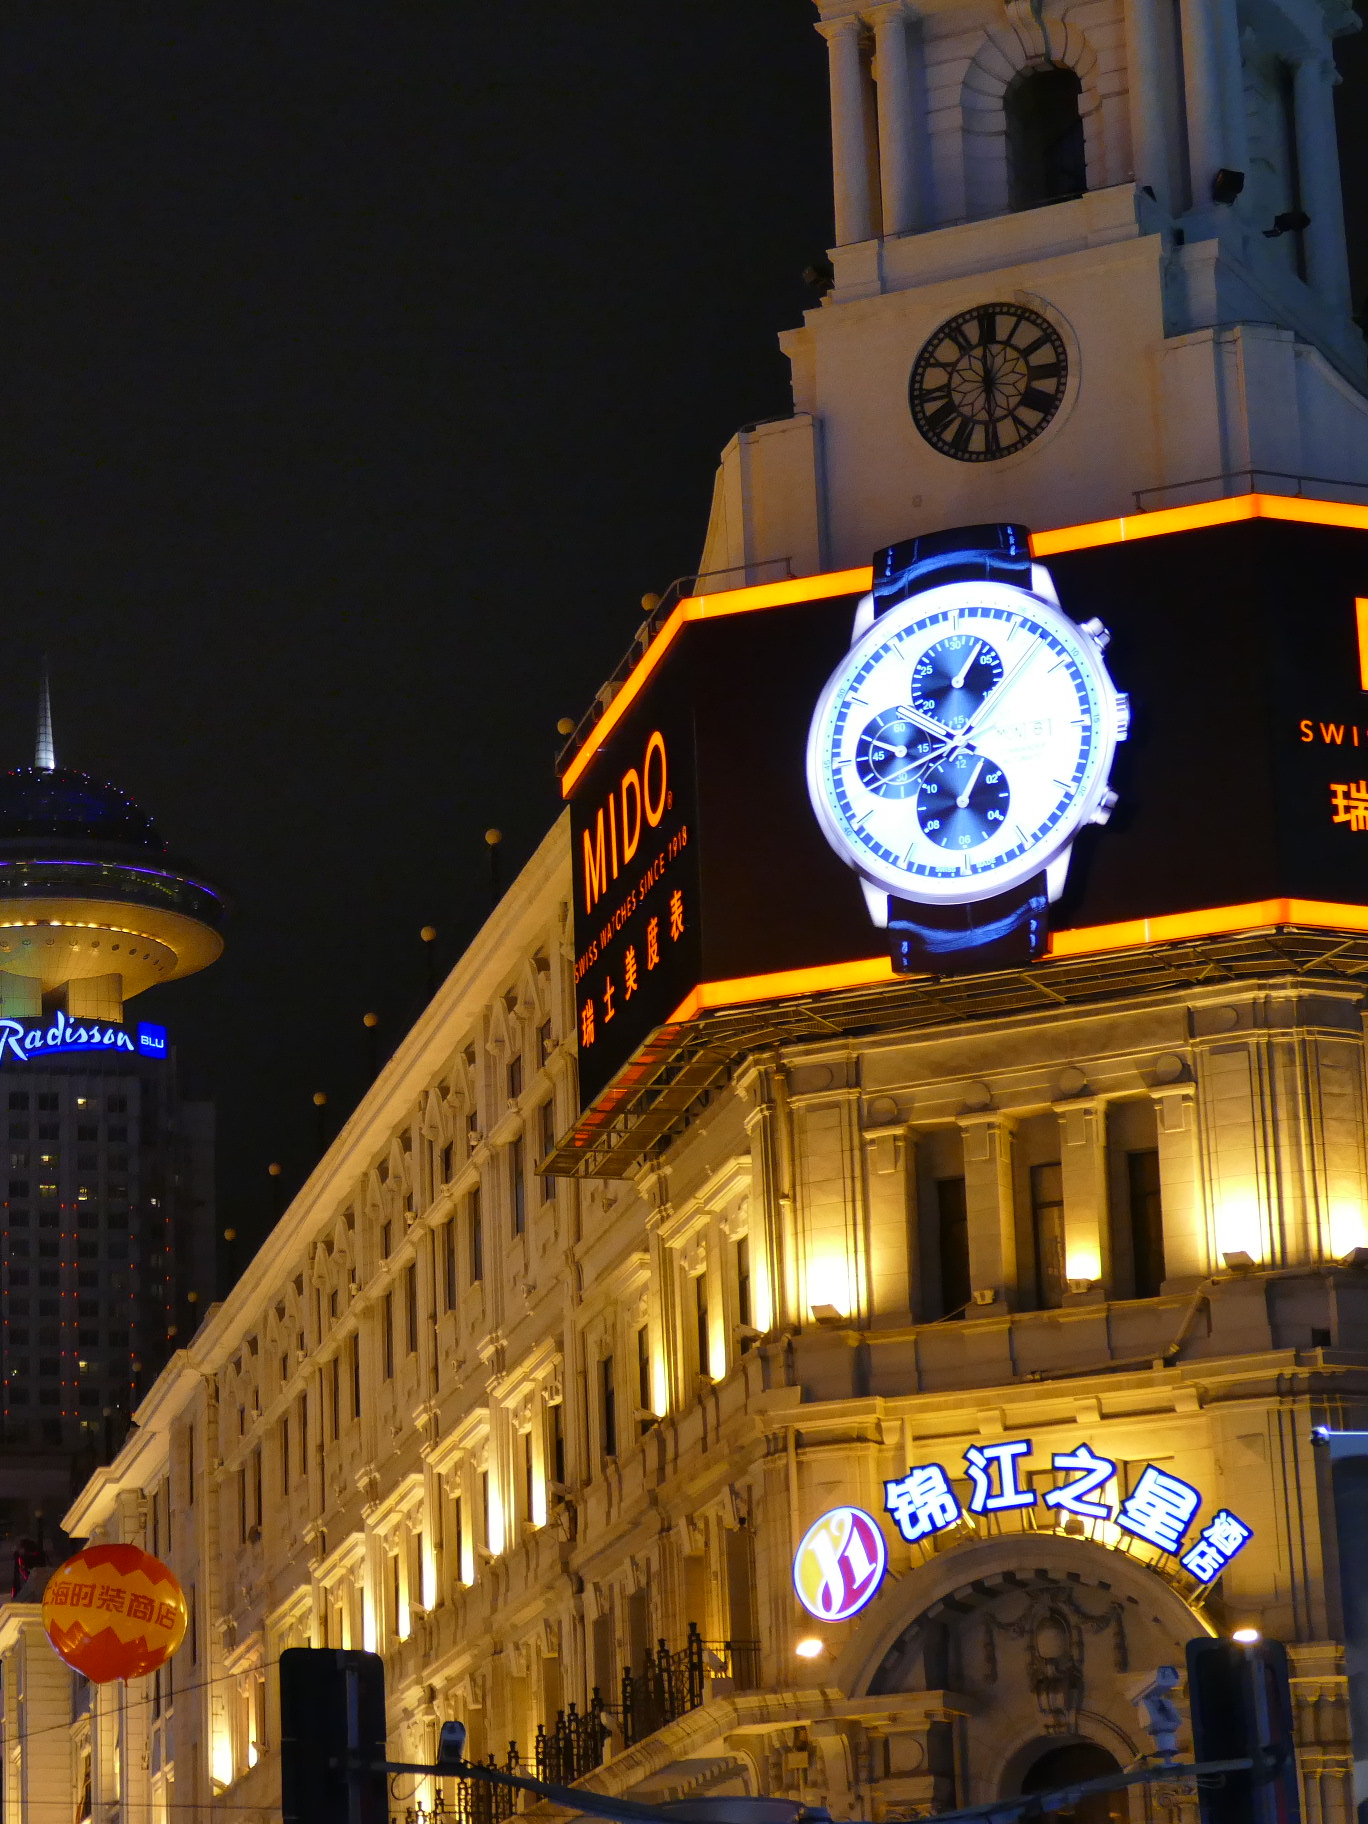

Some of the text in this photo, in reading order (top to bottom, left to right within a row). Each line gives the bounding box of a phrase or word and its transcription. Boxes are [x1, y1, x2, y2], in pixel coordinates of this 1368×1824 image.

[949, 640, 962, 651] 30
[1070, 647, 1080, 657] 10
[979, 654, 993, 665] 05
[920, 665, 933, 676] 25
[922, 700, 936, 710] 20
[953, 715, 964, 724] 15
[893, 723, 906, 733] 60
[1299, 718, 1368, 747] SWI
[917, 743, 930, 753] 15
[872, 751, 885, 761] 45
[955, 760, 967, 769] 12
[986, 774, 999, 784] 02
[926, 784, 938, 794] 10
[987, 809, 1000, 820] 04
[583, 730, 667, 915] MIDO
[927, 820, 940, 830] 08
[958, 834, 971, 845] 06
[574, 824, 688, 984] SWISS WATCHES SINCE 1918
[581, 889, 685, 1049] 瑞士美度表
[140, 1034, 164, 1049] BLU
